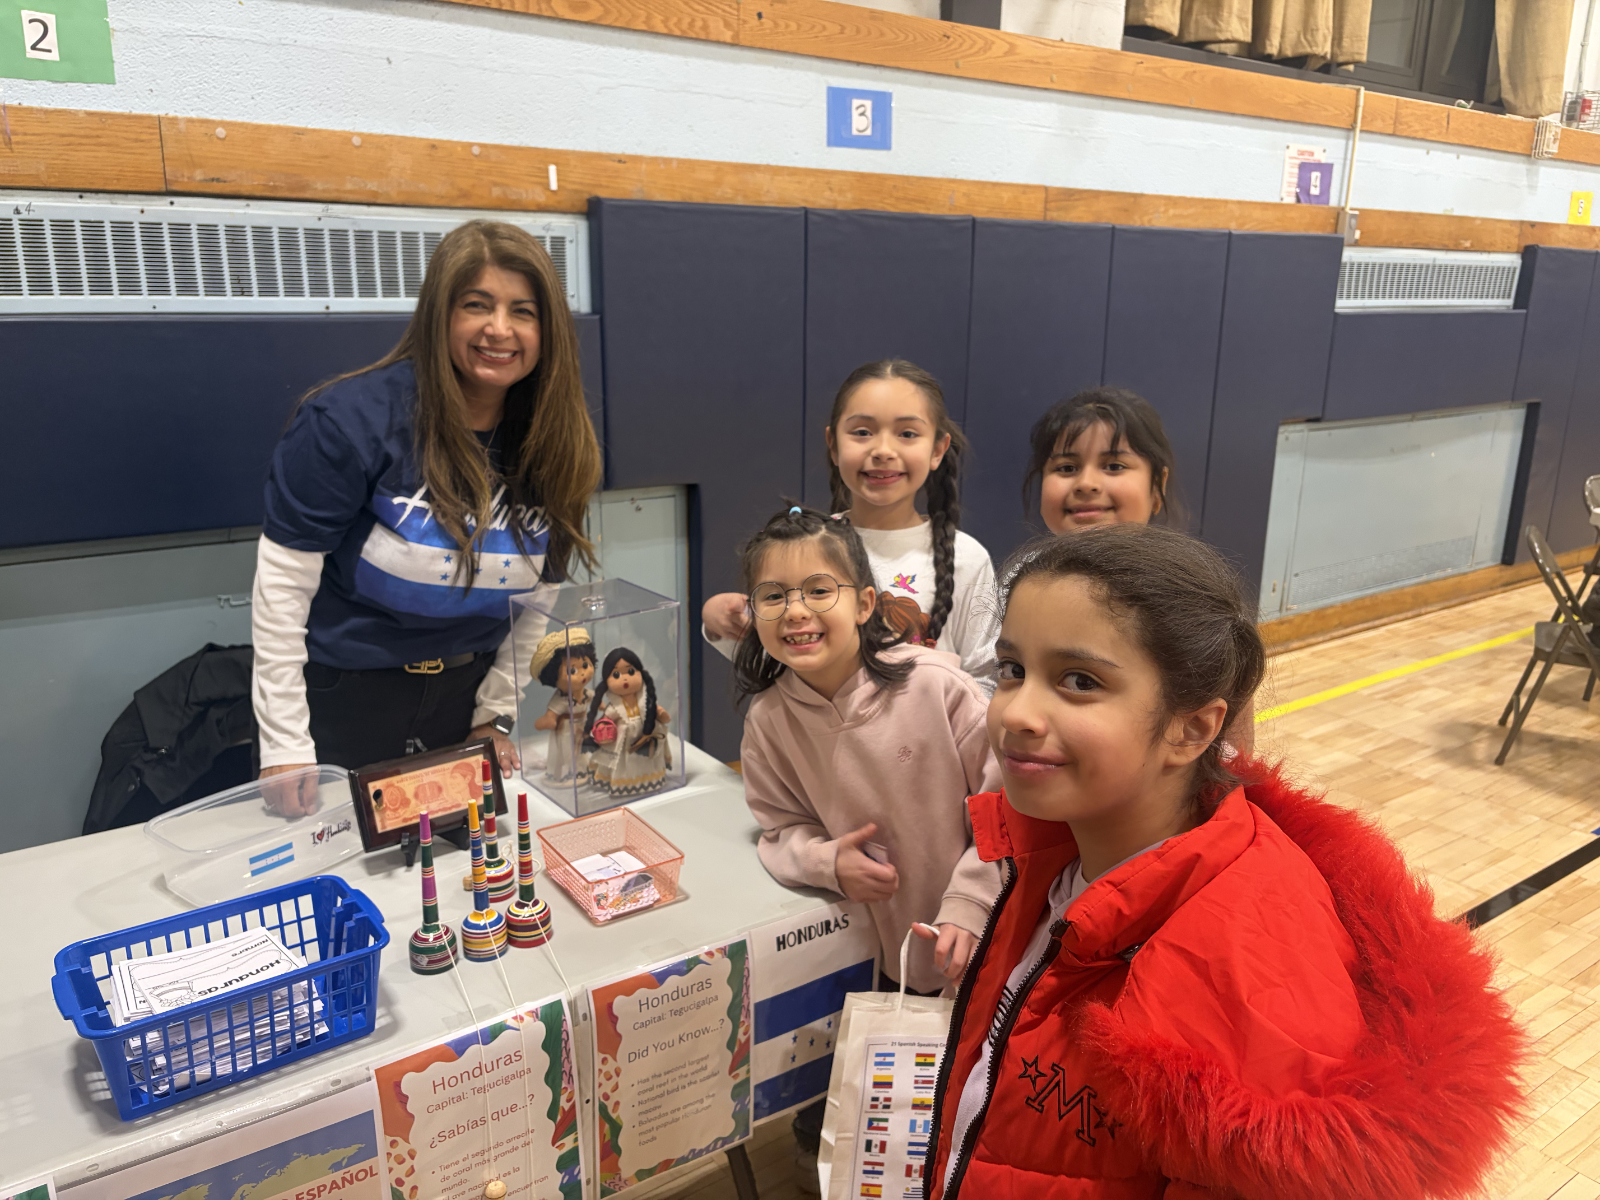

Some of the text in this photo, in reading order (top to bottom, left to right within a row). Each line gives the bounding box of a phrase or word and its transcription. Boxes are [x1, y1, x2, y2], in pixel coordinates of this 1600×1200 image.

[28, 18, 53, 54] 2
[855, 104, 870, 133] 3
[775, 913, 850, 952] HONDURAS
[197, 958, 281, 998] Honduras
[638, 976, 713, 1013] Honduras
[632, 993, 719, 1031] Capital: Tegucigalpa
[627, 1018, 725, 1064] Did You Know...?
[917, 1041, 939, 1049] Speaking
[432, 1050, 523, 1094] Honduras
[637, 1077, 650, 1086] Has
[651, 1072, 662, 1080] the
[663, 1062, 687, 1076] second
[637, 1084, 655, 1096] coral
[655, 1079, 669, 1089] reef
[678, 1072, 689, 1080] the
[690, 1064, 708, 1076] world
[426, 1066, 532, 1114] Capital: Tegucigalpa
[637, 1090, 665, 1107] National
[666, 1085, 680, 1096] bird
[687, 1079, 698, 1087] the
[1025, 1063, 1097, 1147] M
[429, 1094, 535, 1149] ¿Sabías que...?
[638, 1104, 662, 1117] macaw
[638, 1111, 669, 1127] Baleadas
[670, 1107, 681, 1115] are
[682, 1097, 704, 1110] among
[638, 1126, 655, 1137] most
[655, 1116, 681, 1132] popular
[638, 1135, 657, 1147] foods
[438, 1159, 460, 1173] Tiene
[461, 1154, 470, 1163] el
[440, 1174, 451, 1183] de
[452, 1164, 473, 1178] coral
[474, 1157, 491, 1169] más
[493, 1145, 520, 1163] grande
[502, 1170, 511, 1178] es
[512, 1166, 520, 1174] la
[295, 1165, 378, 1200] ESPAÑOL
[441, 1178, 471, 1194] mundo.
